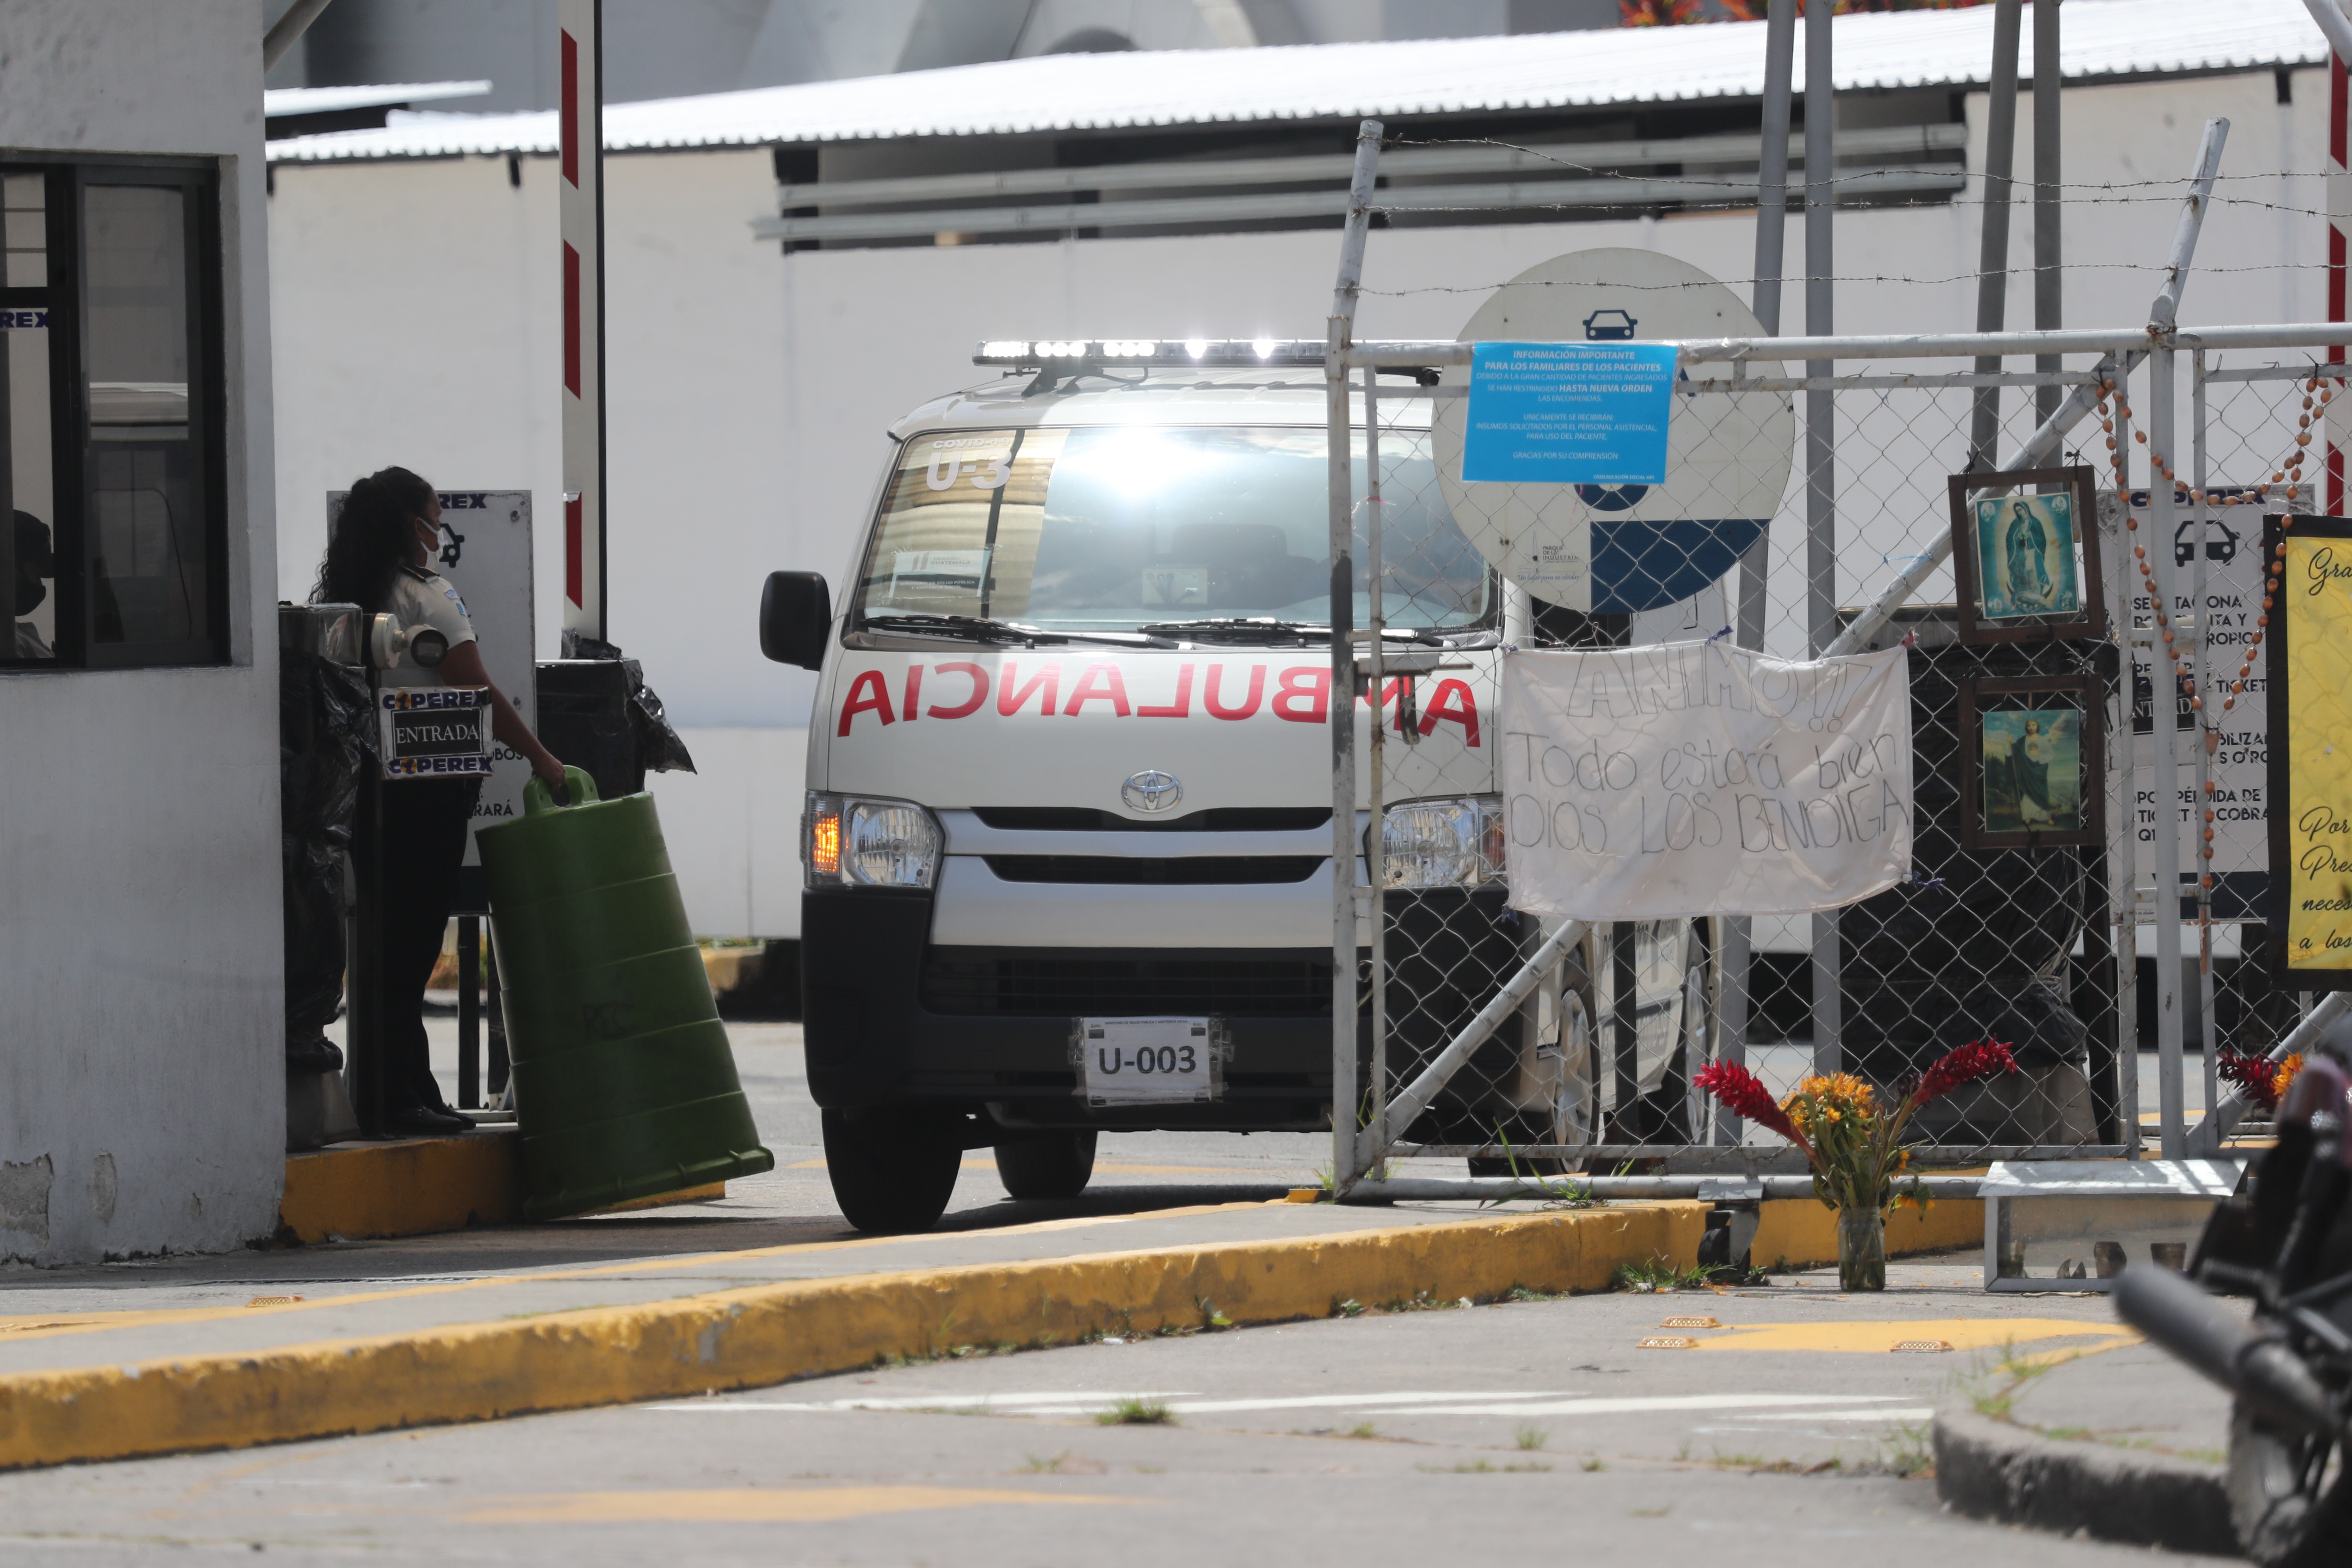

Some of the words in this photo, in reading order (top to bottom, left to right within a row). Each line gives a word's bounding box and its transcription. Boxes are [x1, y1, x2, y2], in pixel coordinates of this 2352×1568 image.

[1513, 350, 1576, 359] INFORMACIÓN
[1578, 351, 1635, 359] IMPORTANTE
[1529, 363, 1580, 371] FAMILIARES
[933, 438, 1010, 449] COVID-19
[927, 448, 1012, 490] U-3
[2216, 679, 2266, 693] TIKET
[395, 724, 479, 744] ENTRADA
[1506, 732, 1637, 791] Todo
[1661, 738, 1785, 790] estará
[1816, 733, 1896, 789] bien
[2242, 789, 2261, 801] DE
[1510, 794, 1607, 854] DIOS
[1641, 792, 1722, 854] LOS
[1735, 779, 1909, 852] BENDIGA
[2300, 806, 2351, 842] Por
[2300, 937, 2312, 949] a
[1099, 1046, 1196, 1074] U-003
